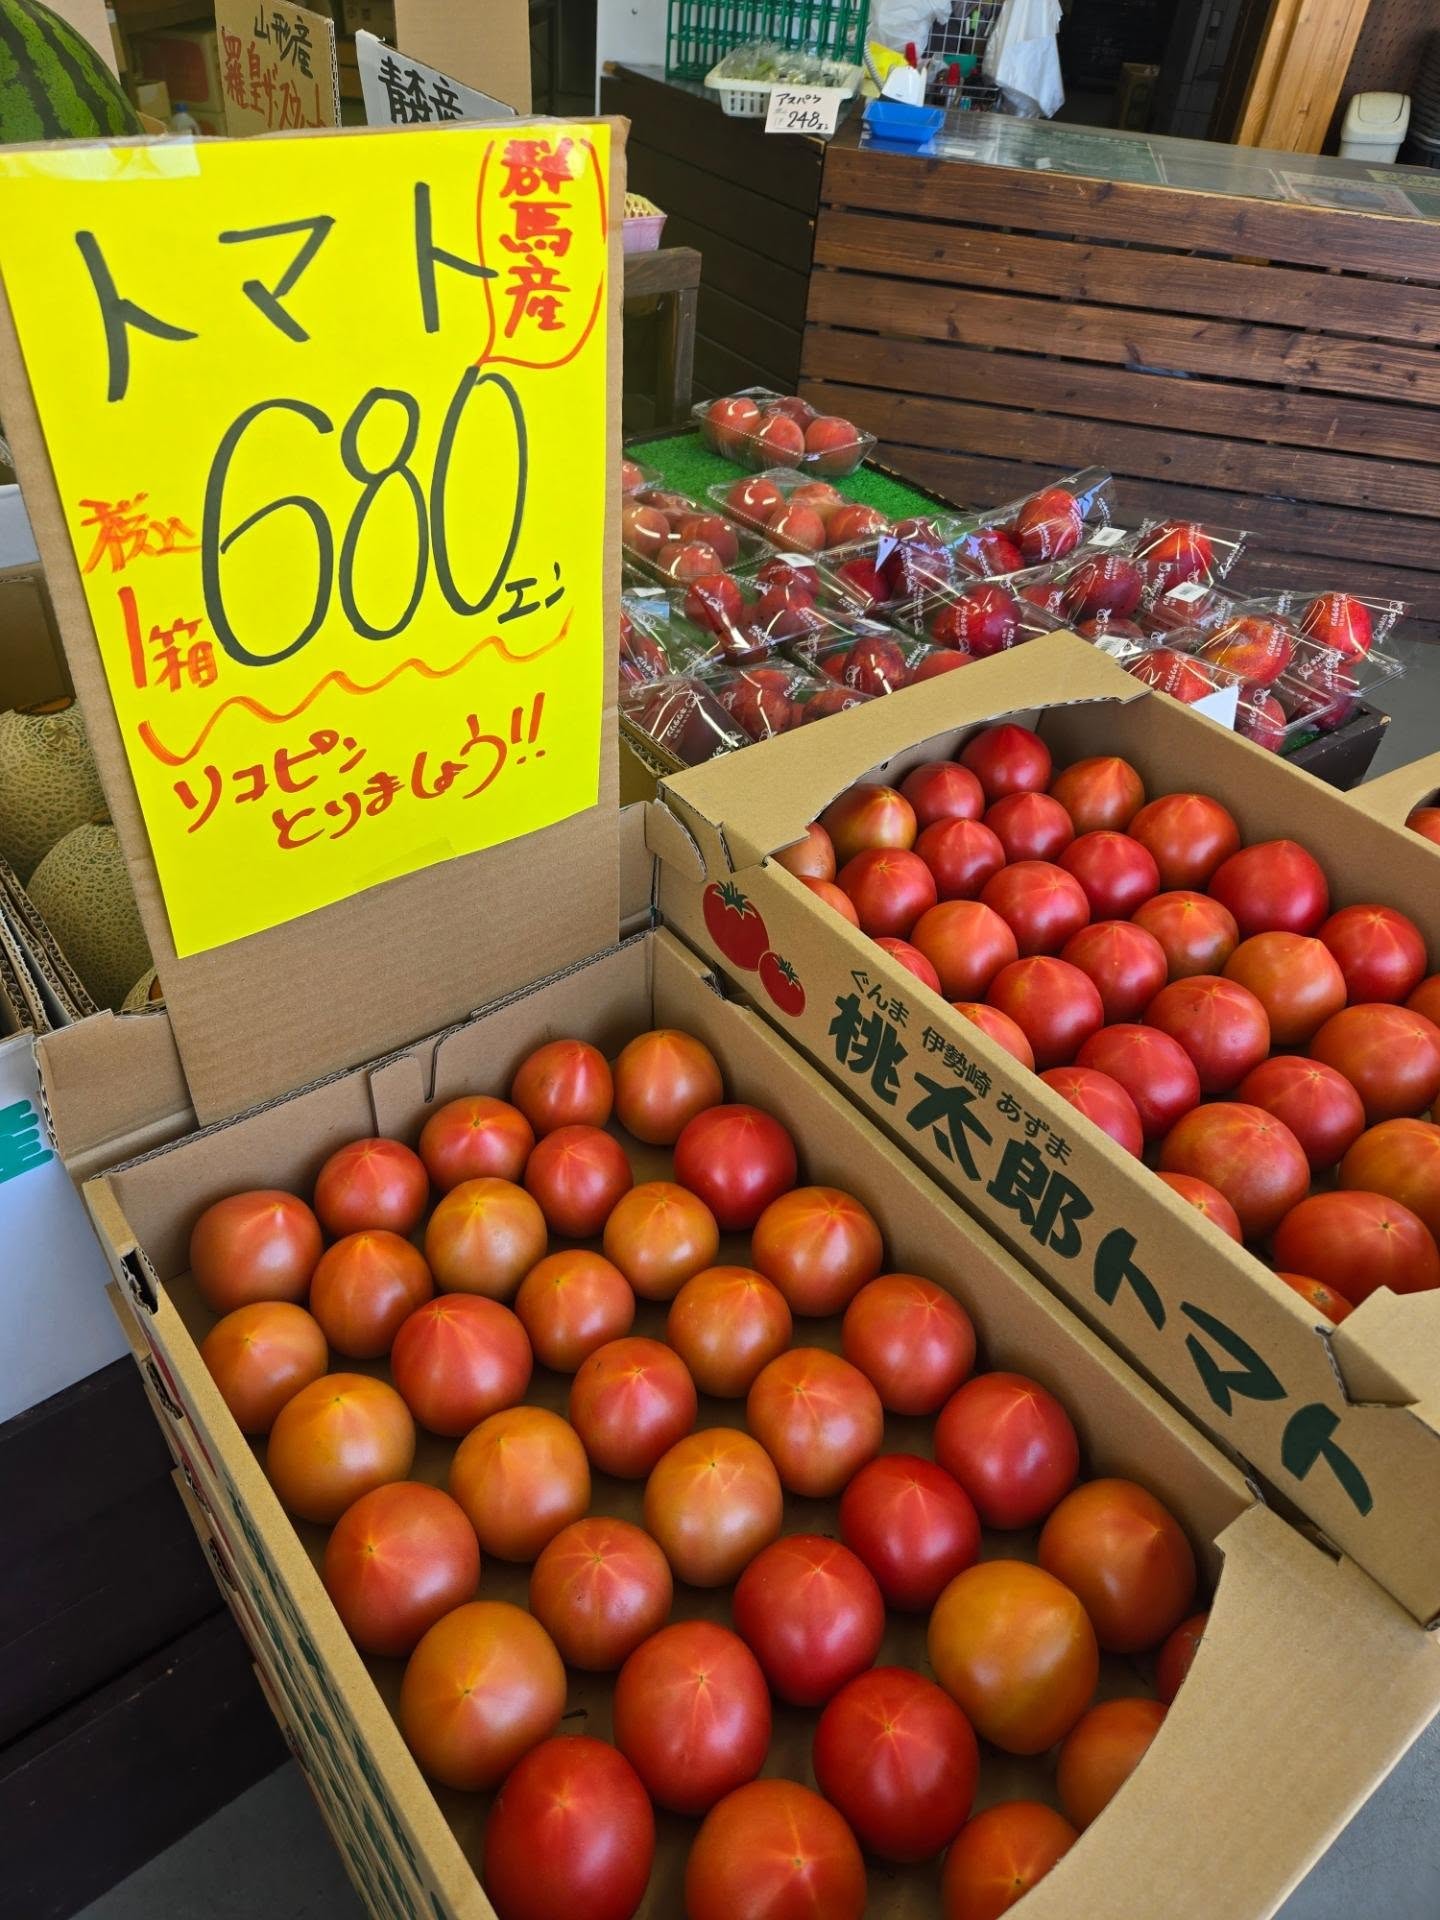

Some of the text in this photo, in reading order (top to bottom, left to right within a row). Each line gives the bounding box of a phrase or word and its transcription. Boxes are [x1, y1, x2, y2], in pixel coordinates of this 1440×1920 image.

[254, 4, 314, 80] 山形産
[75, 181, 499, 403] トマト
[499, 137, 574, 338] 群馬産
[79, 493, 203, 574] 税込
[118, 586, 219, 692] 1箱
[172, 729, 368, 834] リコピン
[850, 968, 1073, 1167] ぐんま 伊勢崎 あずま
[827, 992, 1374, 1517] 桃太郎トマト
